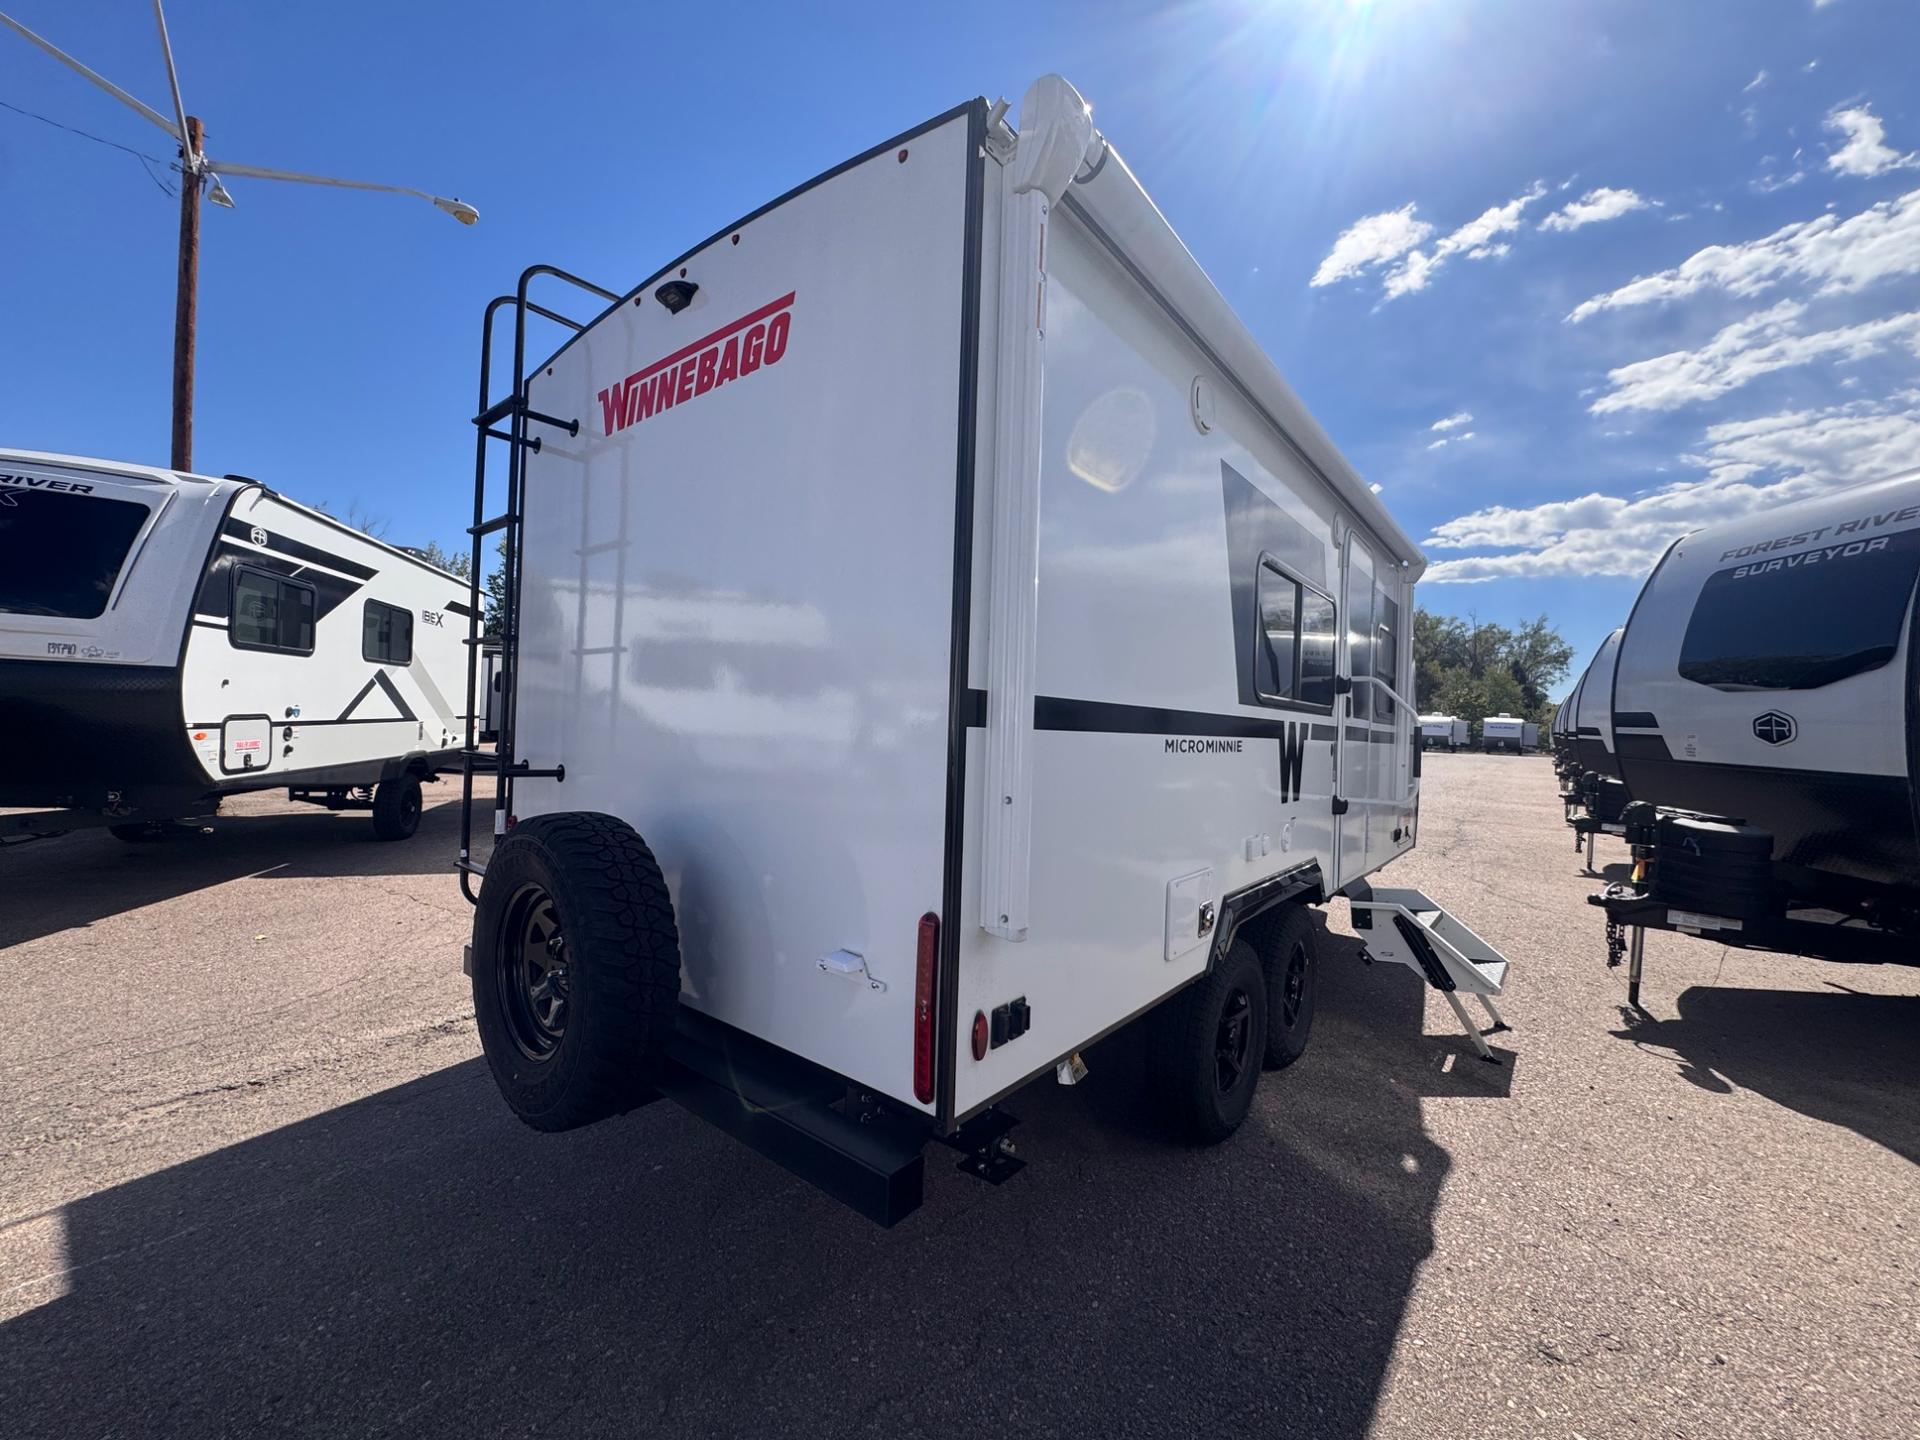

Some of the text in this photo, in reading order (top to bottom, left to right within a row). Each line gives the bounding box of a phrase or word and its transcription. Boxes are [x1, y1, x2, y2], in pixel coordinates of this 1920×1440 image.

[597, 310, 792, 437] WINNEBAGO
[0, 474, 95, 495] RIVER
[1719, 505, 1920, 563] FOREST RIVE
[1732, 537, 1890, 580] SURVEYOR
[1164, 738, 1243, 754] MICROMINNIE
